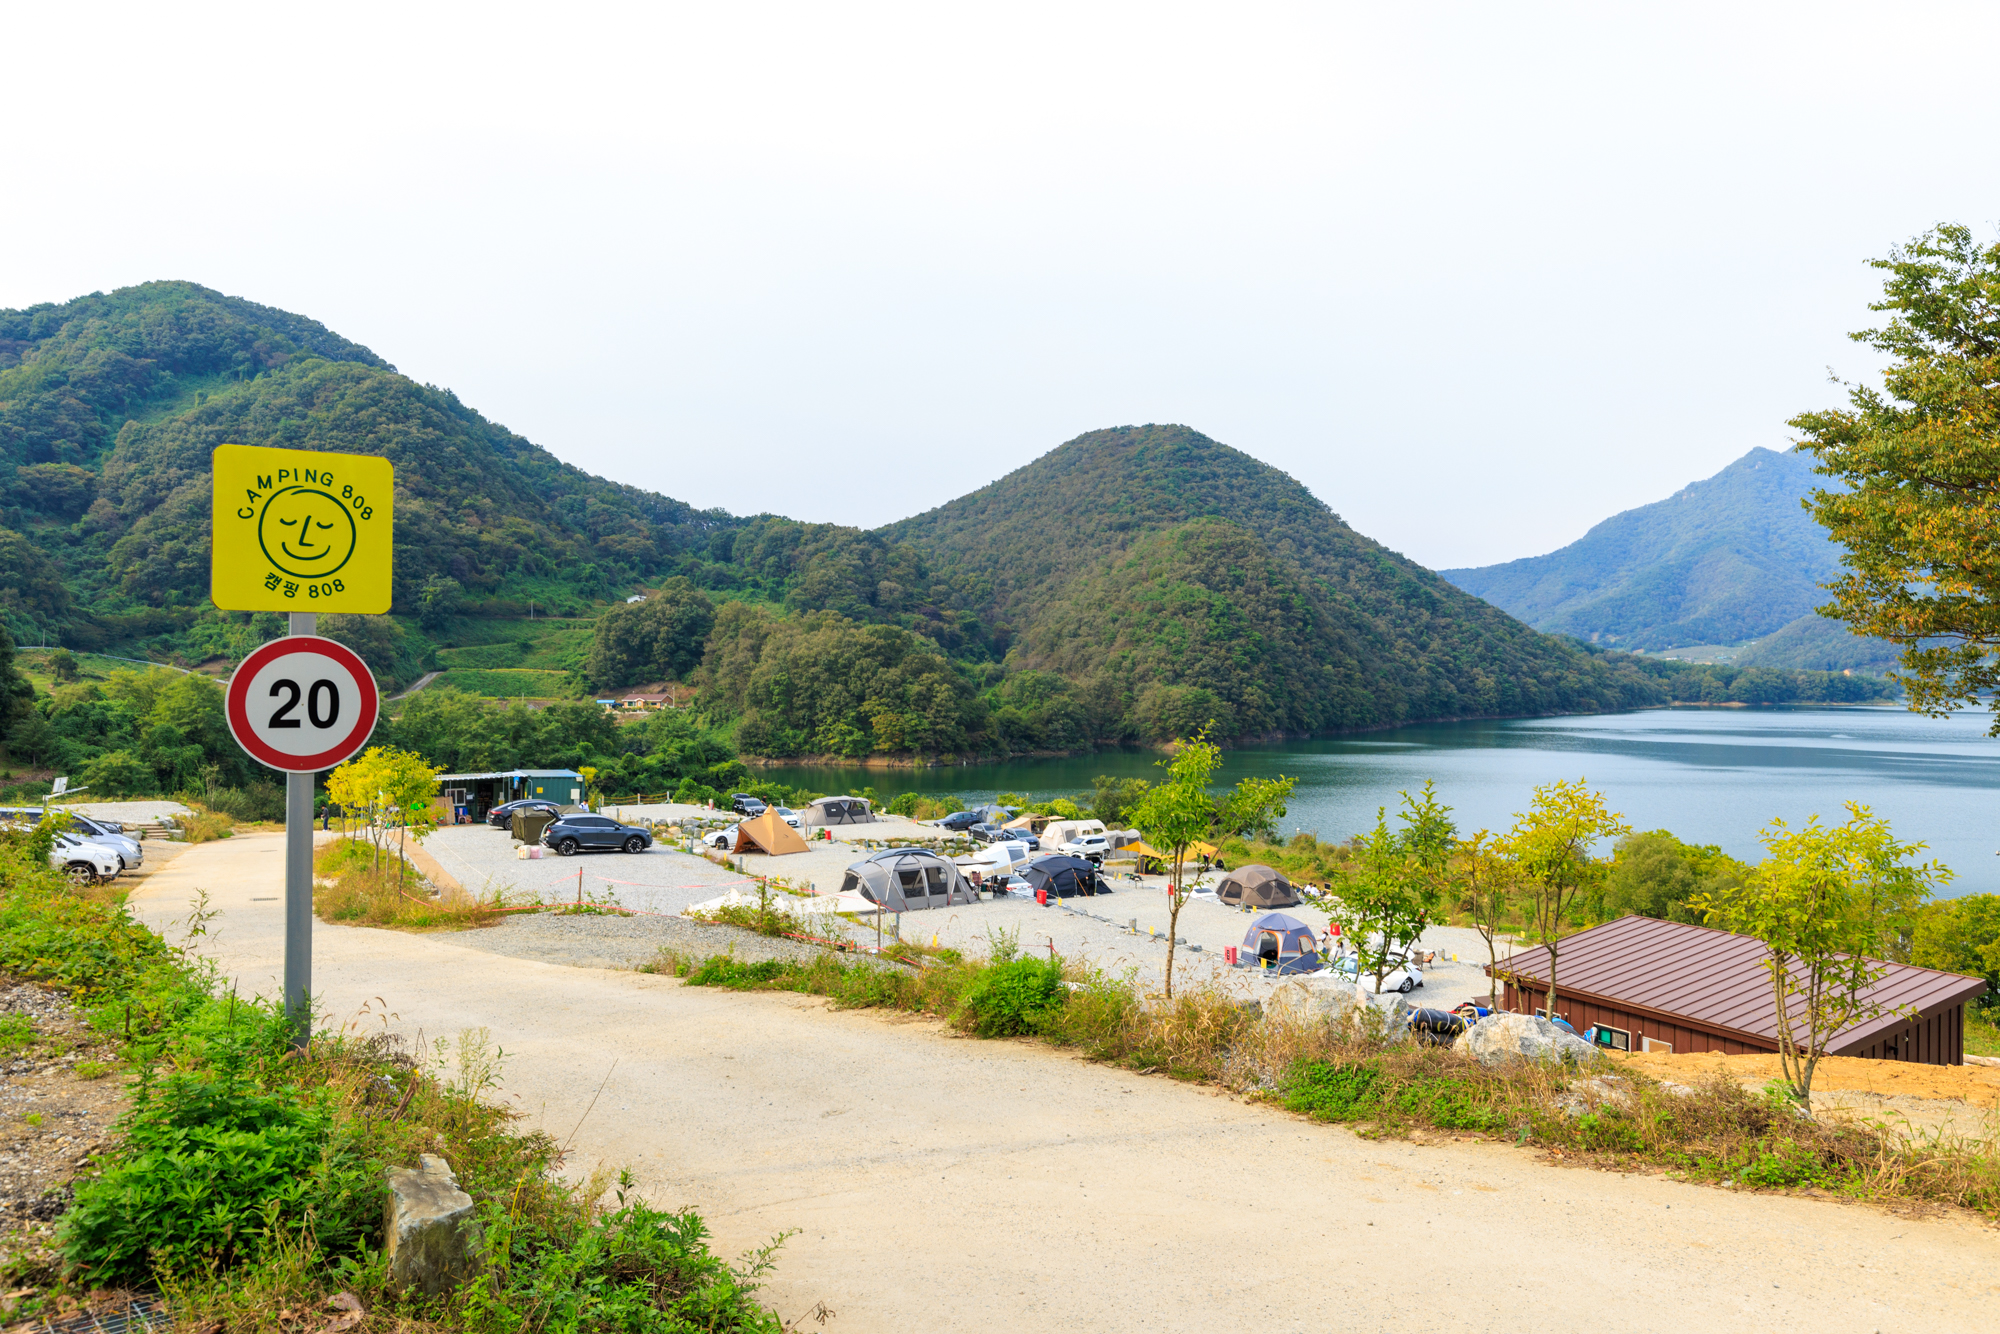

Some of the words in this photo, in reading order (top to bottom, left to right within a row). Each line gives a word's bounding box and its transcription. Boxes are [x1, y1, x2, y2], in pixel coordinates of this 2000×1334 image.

[237, 467, 335, 520] CAMPING
[341, 485, 374, 521] 808
[264, 571, 300, 599] 캠핑
[308, 578, 346, 599] 808
[268, 678, 340, 729] 20
